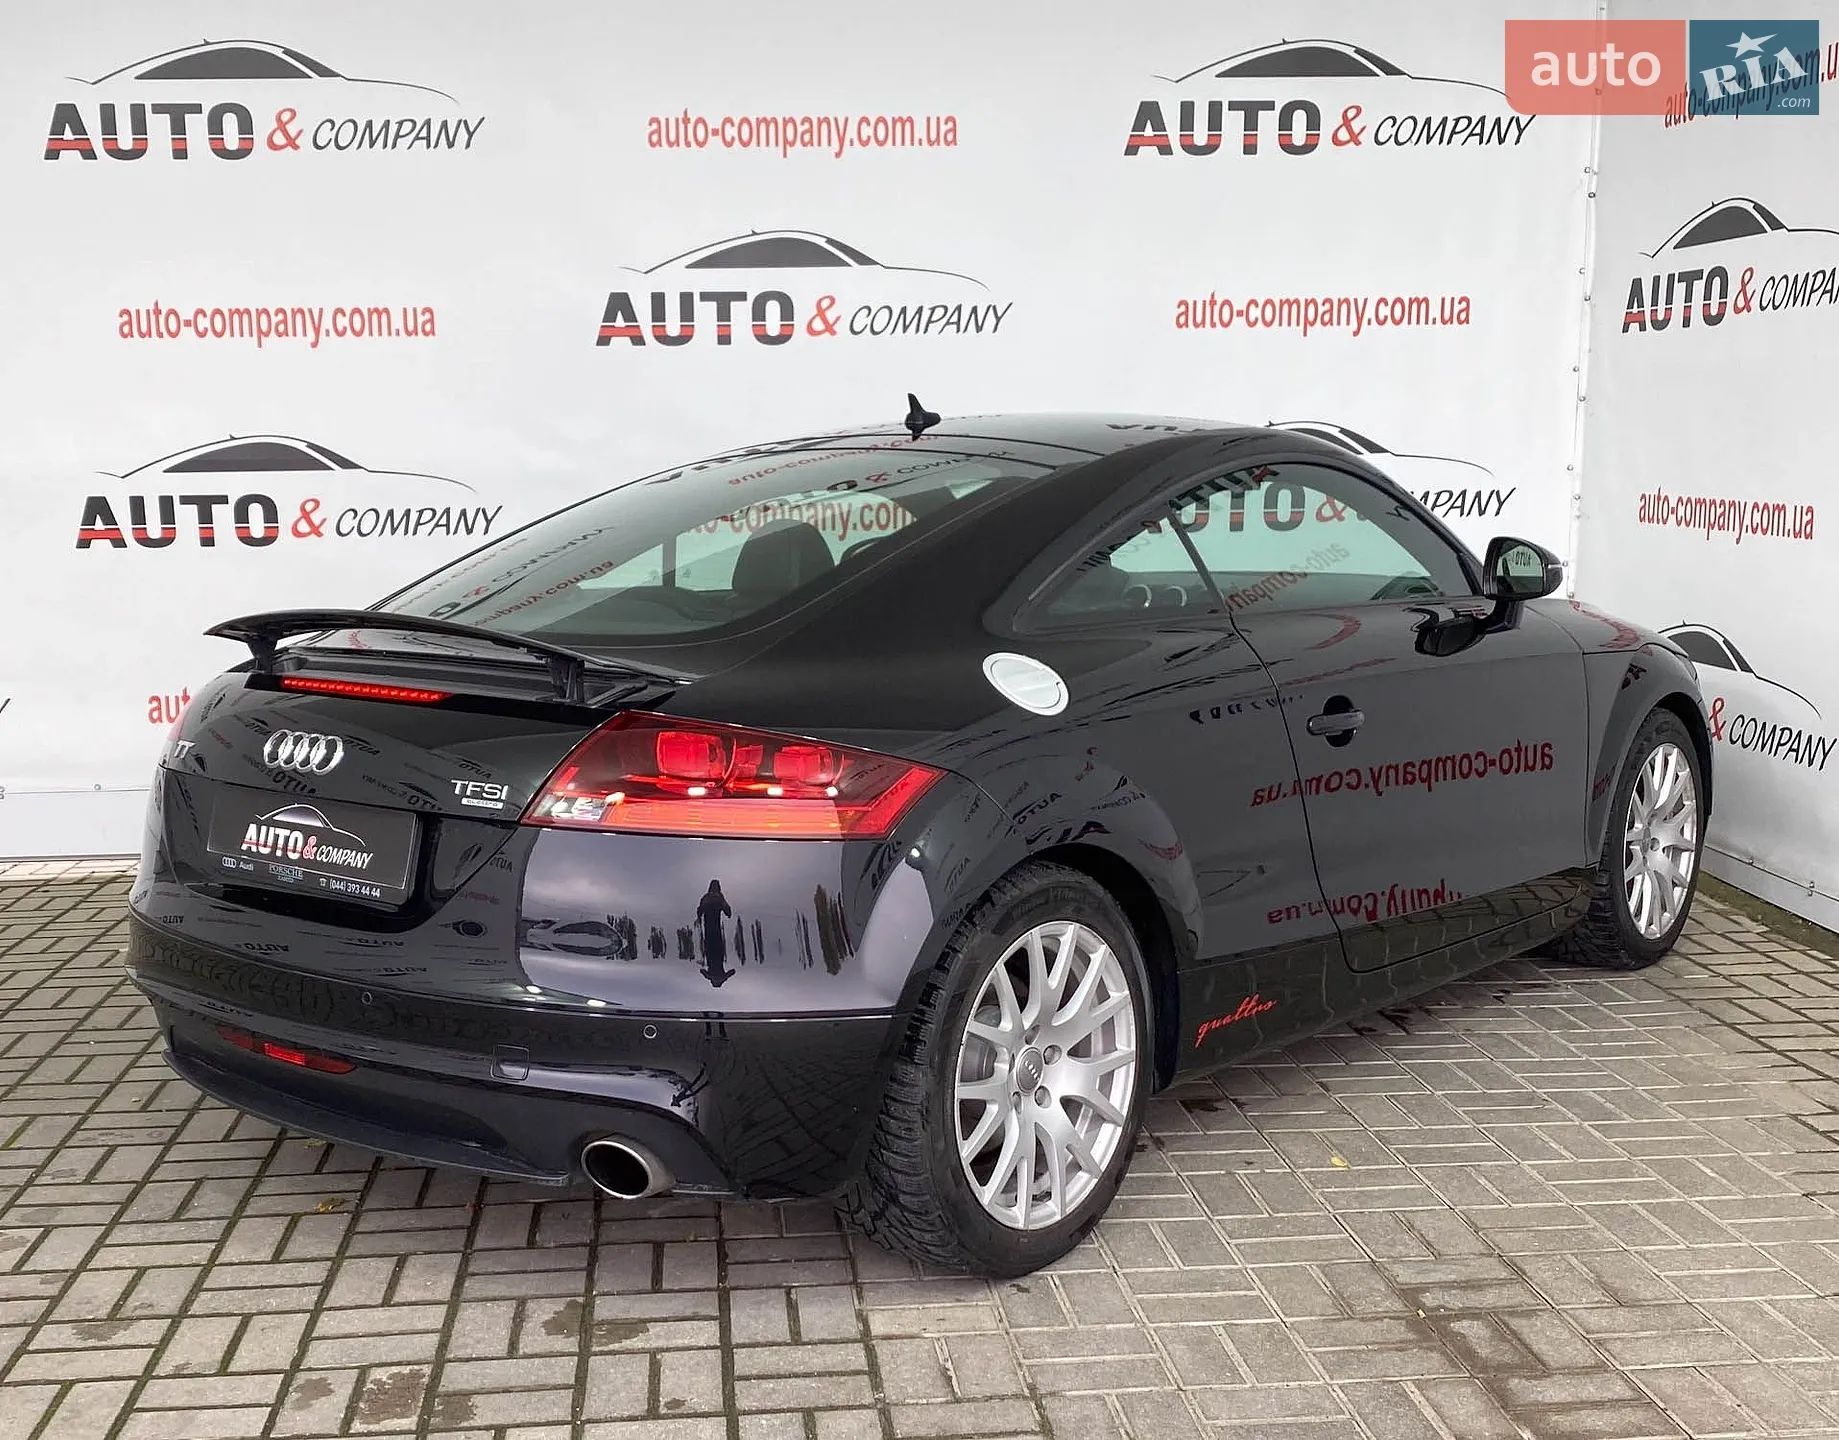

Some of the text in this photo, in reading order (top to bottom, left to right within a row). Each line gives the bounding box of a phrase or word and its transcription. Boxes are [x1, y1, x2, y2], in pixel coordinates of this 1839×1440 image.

[44, 103, 485, 160] AUTO & COMPANY
[648, 108, 957, 158] auto-company.com.ua
[1124, 100, 1537, 156] AUTO & COMPANY
[119, 300, 435, 348] auto-company.com.ua
[596, 291, 1013, 346] AUTO & COMPANY
[1176, 292, 1470, 337] auto-company.com.ua
[1622, 266, 1839, 333] AUTO & COMPA
[76, 494, 503, 549] AUTO & COMPANY
[1639, 487, 1814, 545] auto-company.com.ua
[1709, 698, 1838, 772] & COMPANY
[451, 780, 508, 800] TFSI
[239, 861, 254, 872] Audi
[241, 824, 374, 870] AUTO & COMPANY
[268, 863, 304, 878] PORSCHE
[329, 878, 381, 898] (044) 393 44 44
[1195, 993, 1277, 1049] quattro
